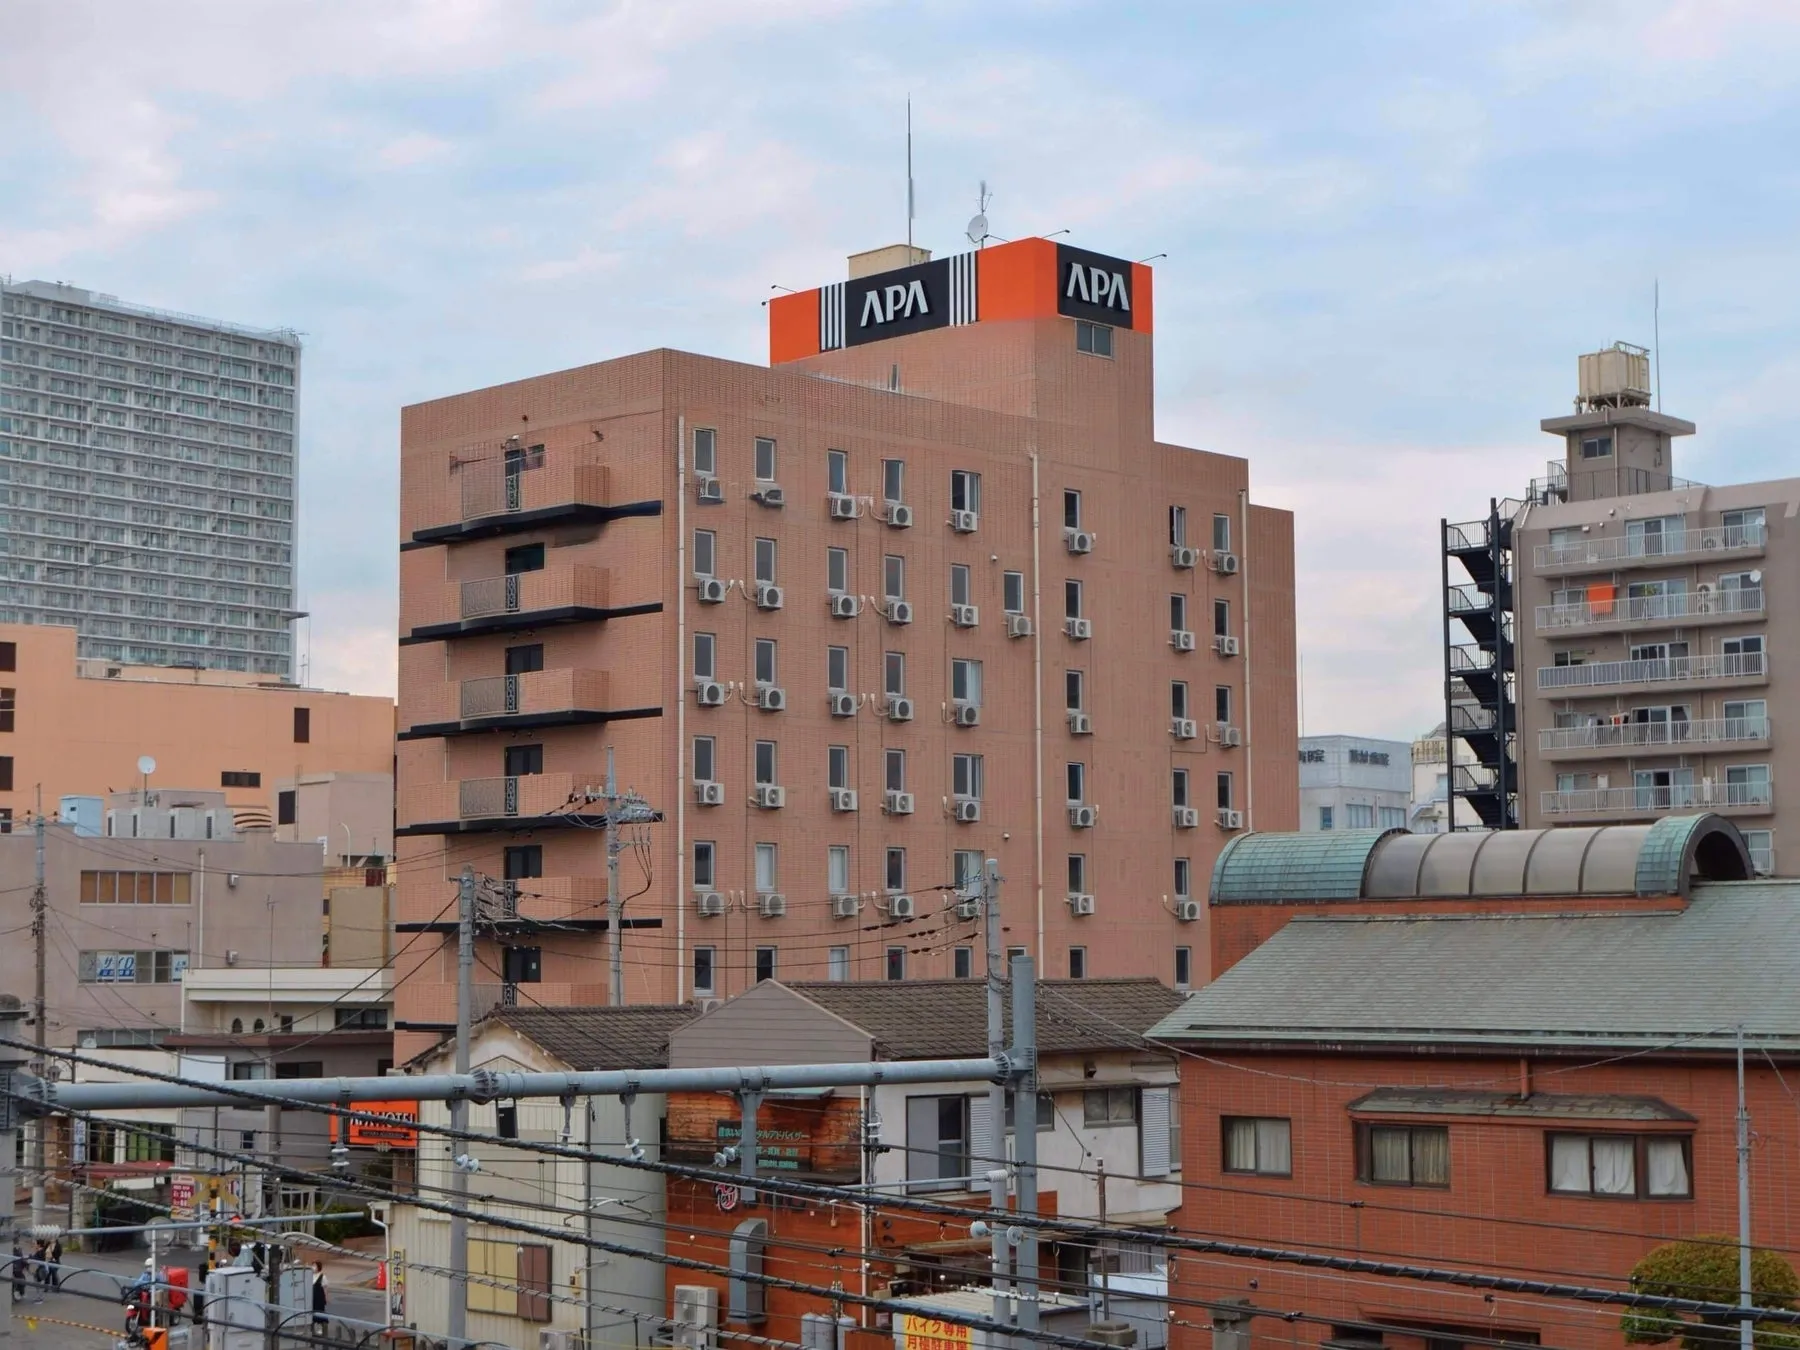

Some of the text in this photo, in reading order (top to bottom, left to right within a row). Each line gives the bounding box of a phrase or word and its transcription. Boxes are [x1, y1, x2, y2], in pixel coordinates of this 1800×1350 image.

[860, 279, 930, 328] APA
[1066, 262, 1131, 311] APA
[906, 1315, 968, 1338] バイク専用
